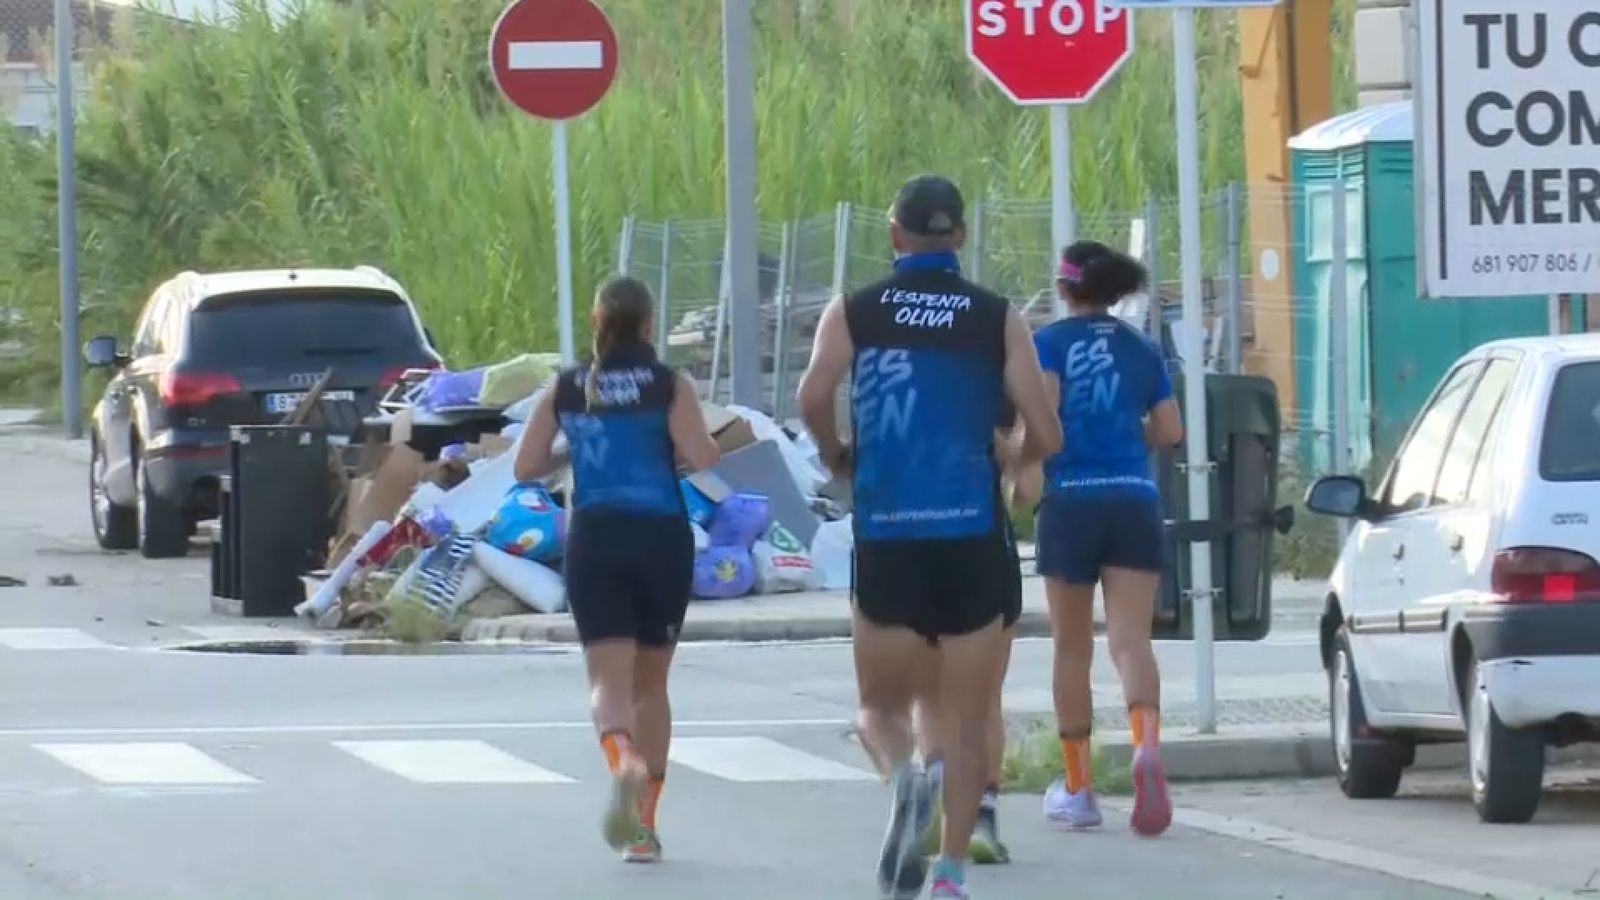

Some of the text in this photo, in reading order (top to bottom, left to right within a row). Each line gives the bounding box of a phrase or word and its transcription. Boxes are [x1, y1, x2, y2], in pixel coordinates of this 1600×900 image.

[977, 0, 1122, 36] STOP
[1463, 13, 1547, 69] TU
[1469, 168, 1600, 225] MER
[1471, 254, 1500, 274] 681
[1506, 253, 1539, 273] 907
[1545, 252, 1577, 272] 806
[880, 287, 972, 311] L'ESPENTA
[895, 306, 954, 329] OLIVA
[1066, 337, 1114, 378] ES
